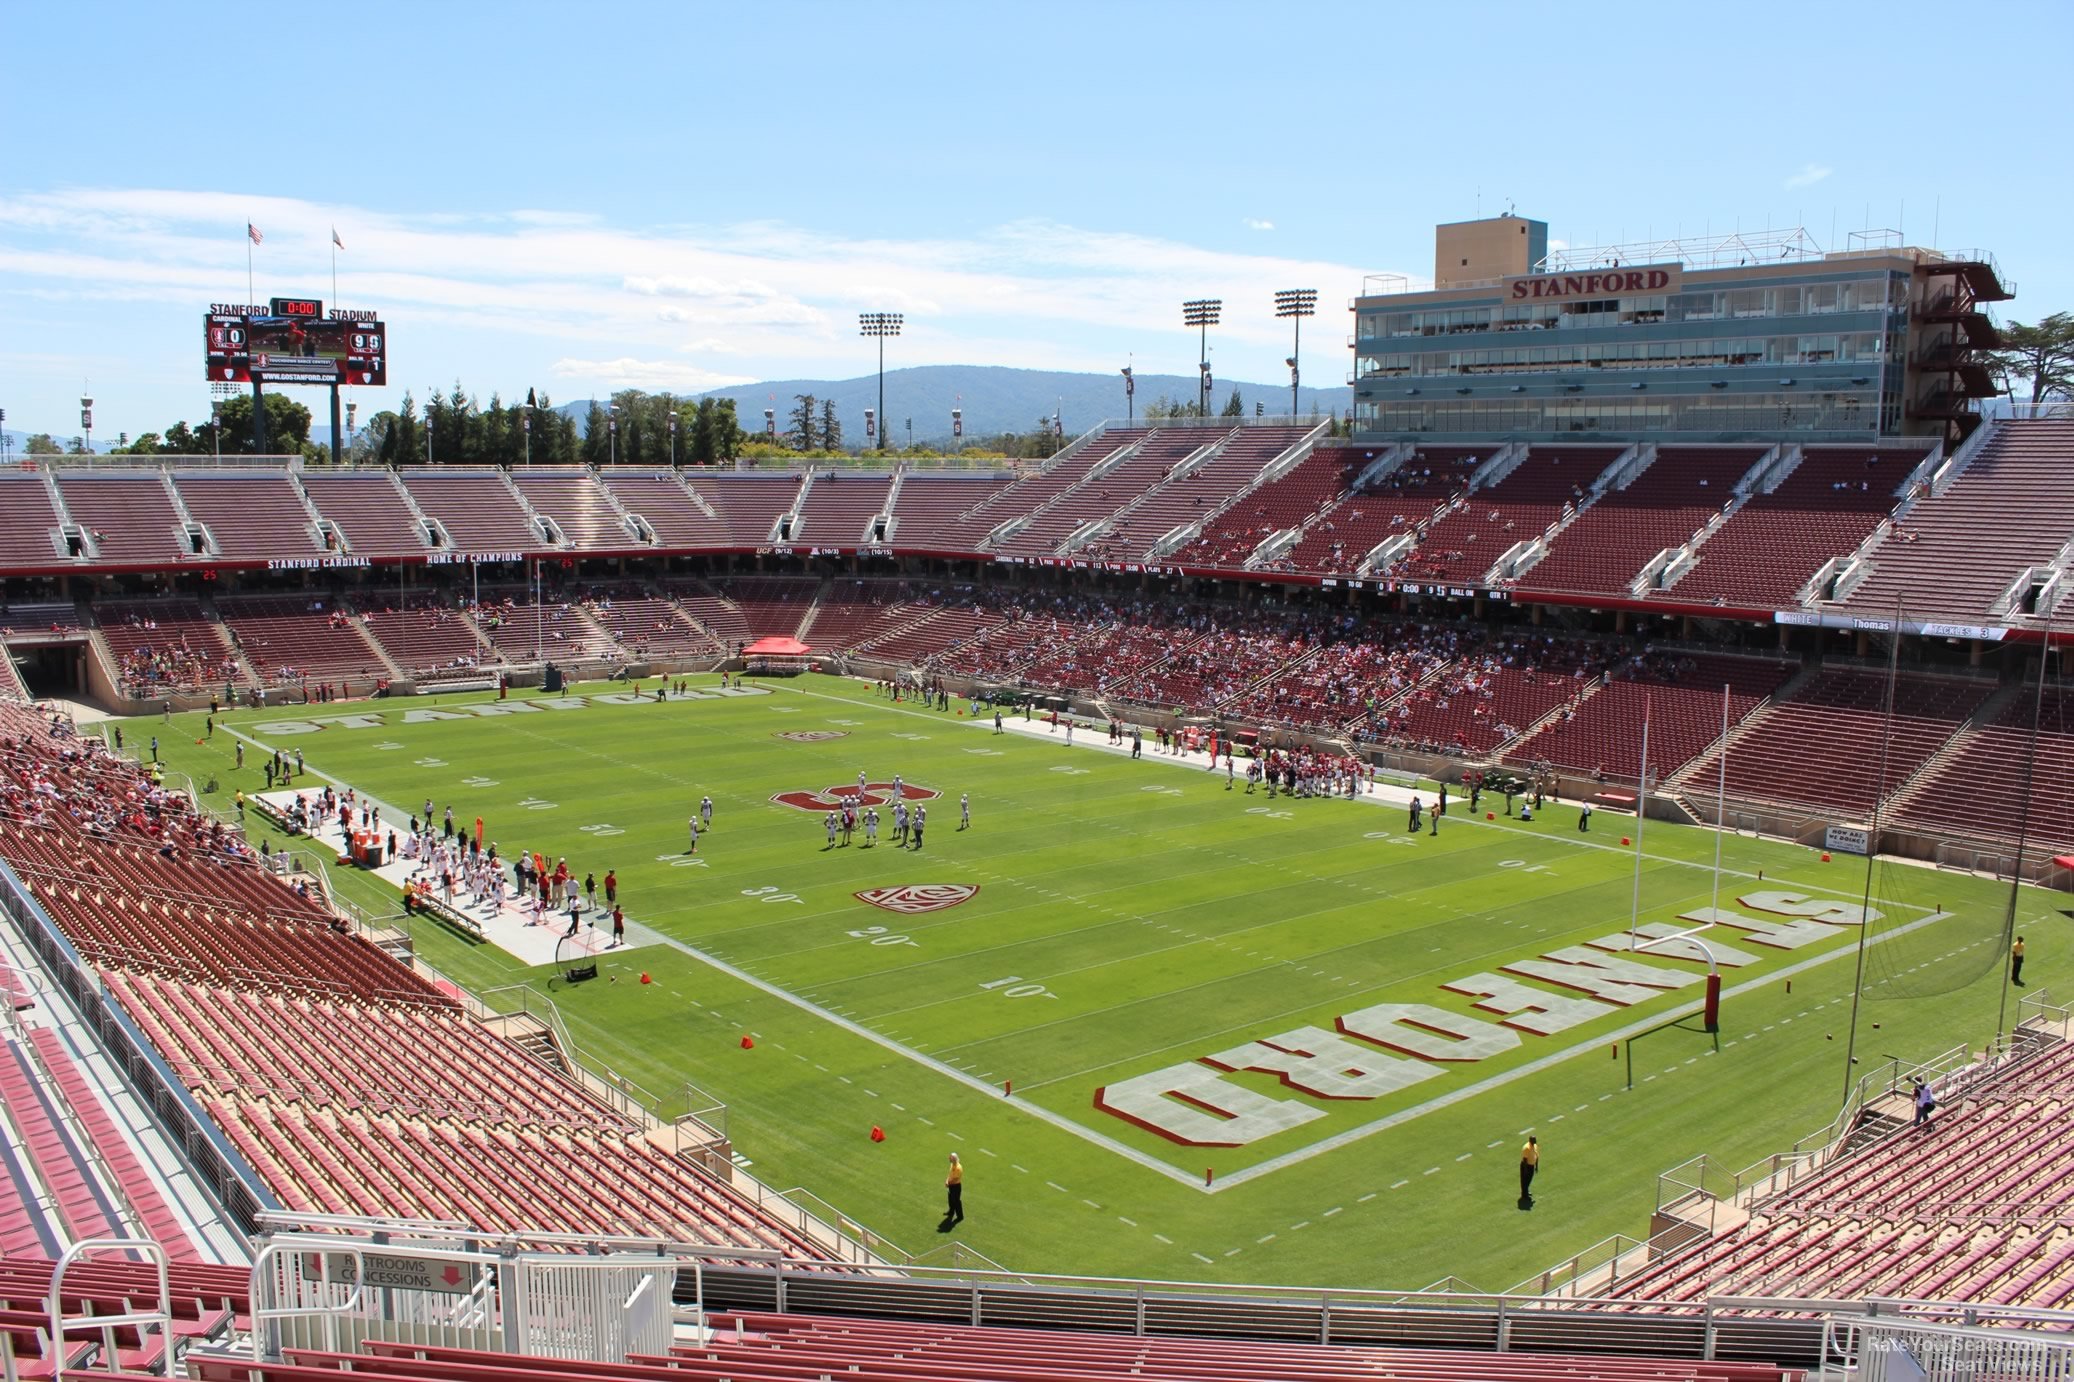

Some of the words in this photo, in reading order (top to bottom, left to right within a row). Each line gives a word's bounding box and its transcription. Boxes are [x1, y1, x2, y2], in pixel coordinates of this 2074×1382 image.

[1513, 270, 1668, 298] STANFORD
[210, 304, 269, 316] STANFORD
[329, 309, 377, 321] STADIUM
[288, 302, 314, 314] 0:00
[230, 330, 239, 343] 0
[356, 335, 363, 348] 9
[374, 362, 378, 370] 1
[262, 373, 336, 382] WWW.GOSTANFORD.COM
[268, 559, 320, 569] STANFORD
[323, 557, 371, 567] CARDINAL
[427, 555, 452, 564] HOME
[456, 554, 466, 563] OF
[470, 553, 523, 562] CHAMPIONS
[204, 570, 216, 580] 25
[1322, 578, 1336, 586] DOWN
[1403, 584, 1419, 594] 0:00
[1784, 614, 1812, 624] WHITE
[1853, 618, 1890, 630] Thomas
[1932, 625, 1972, 637] TACKLES
[1980, 628, 1989, 638] 3
[252, 686, 776, 735] STANFORD
[768, 782, 944, 812] S
[580, 824, 626, 836] 50
[656, 854, 704, 866] 40
[1498, 860, 1550, 872] 10
[740, 886, 798, 904] 30
[845, 926, 910, 946] 20
[978, 976, 1046, 999] 10
[1094, 890, 1886, 1148] STANFORD
[345, 1255, 426, 1272] RSTROOMS
